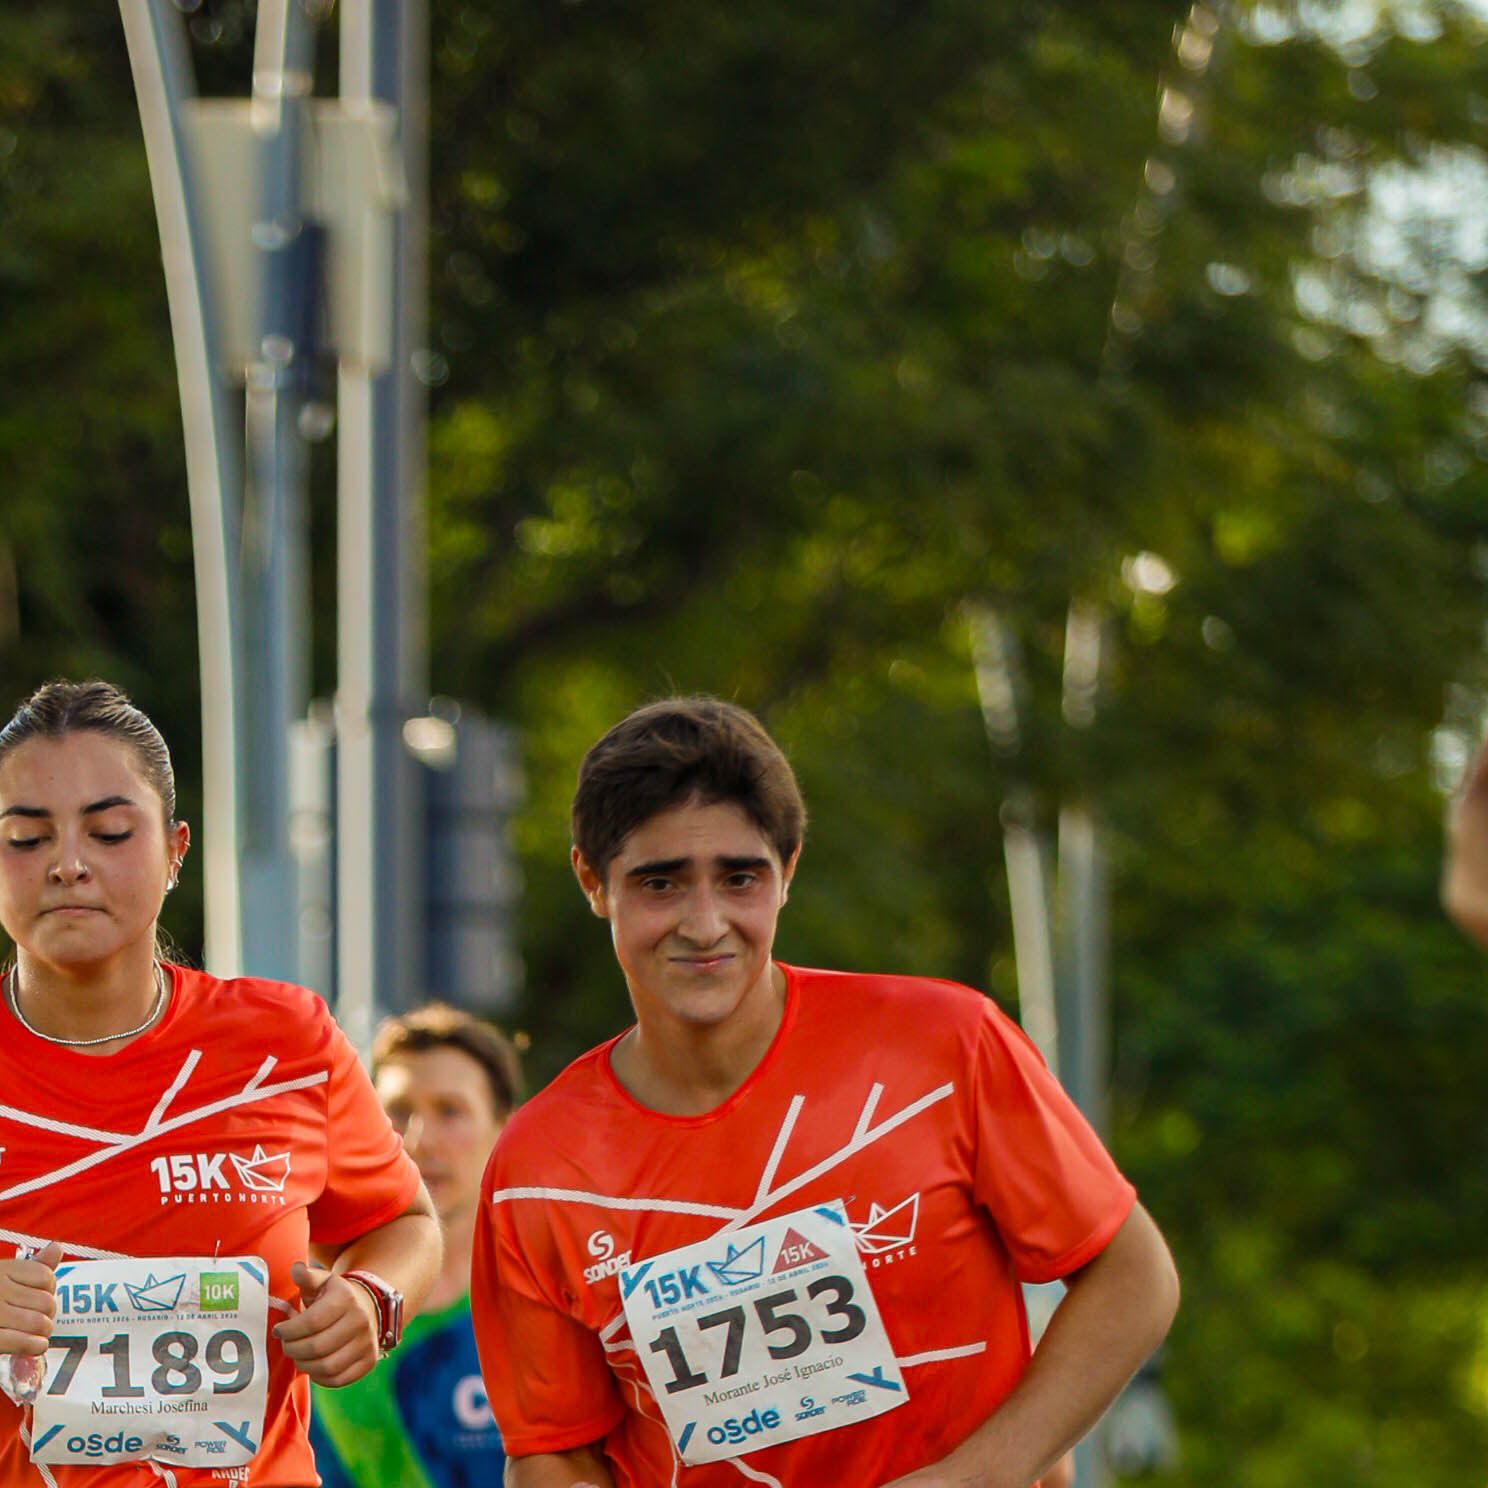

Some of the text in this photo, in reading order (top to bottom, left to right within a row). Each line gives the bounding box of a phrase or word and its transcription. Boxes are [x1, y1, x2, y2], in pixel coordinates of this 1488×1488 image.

[151, 1153, 231, 1193] 15K
[160, 1193, 286, 1206] PUERTO NORTE
[781, 1242, 814, 1265] 15K
[863, 1246, 917, 1272] ORTE
[56, 1283, 119, 1314] 15K
[204, 1283, 235, 1301] 10K
[644, 1264, 709, 1309] 15K
[649, 1275, 867, 1394] 1753
[47, 1329, 255, 1397] 7189
[704, 1355, 844, 1406] Morante José Ignacio
[91, 1399, 209, 1414] Marchesi Josefina
[707, 1408, 781, 1444] osde
[67, 1431, 143, 1457] osde
